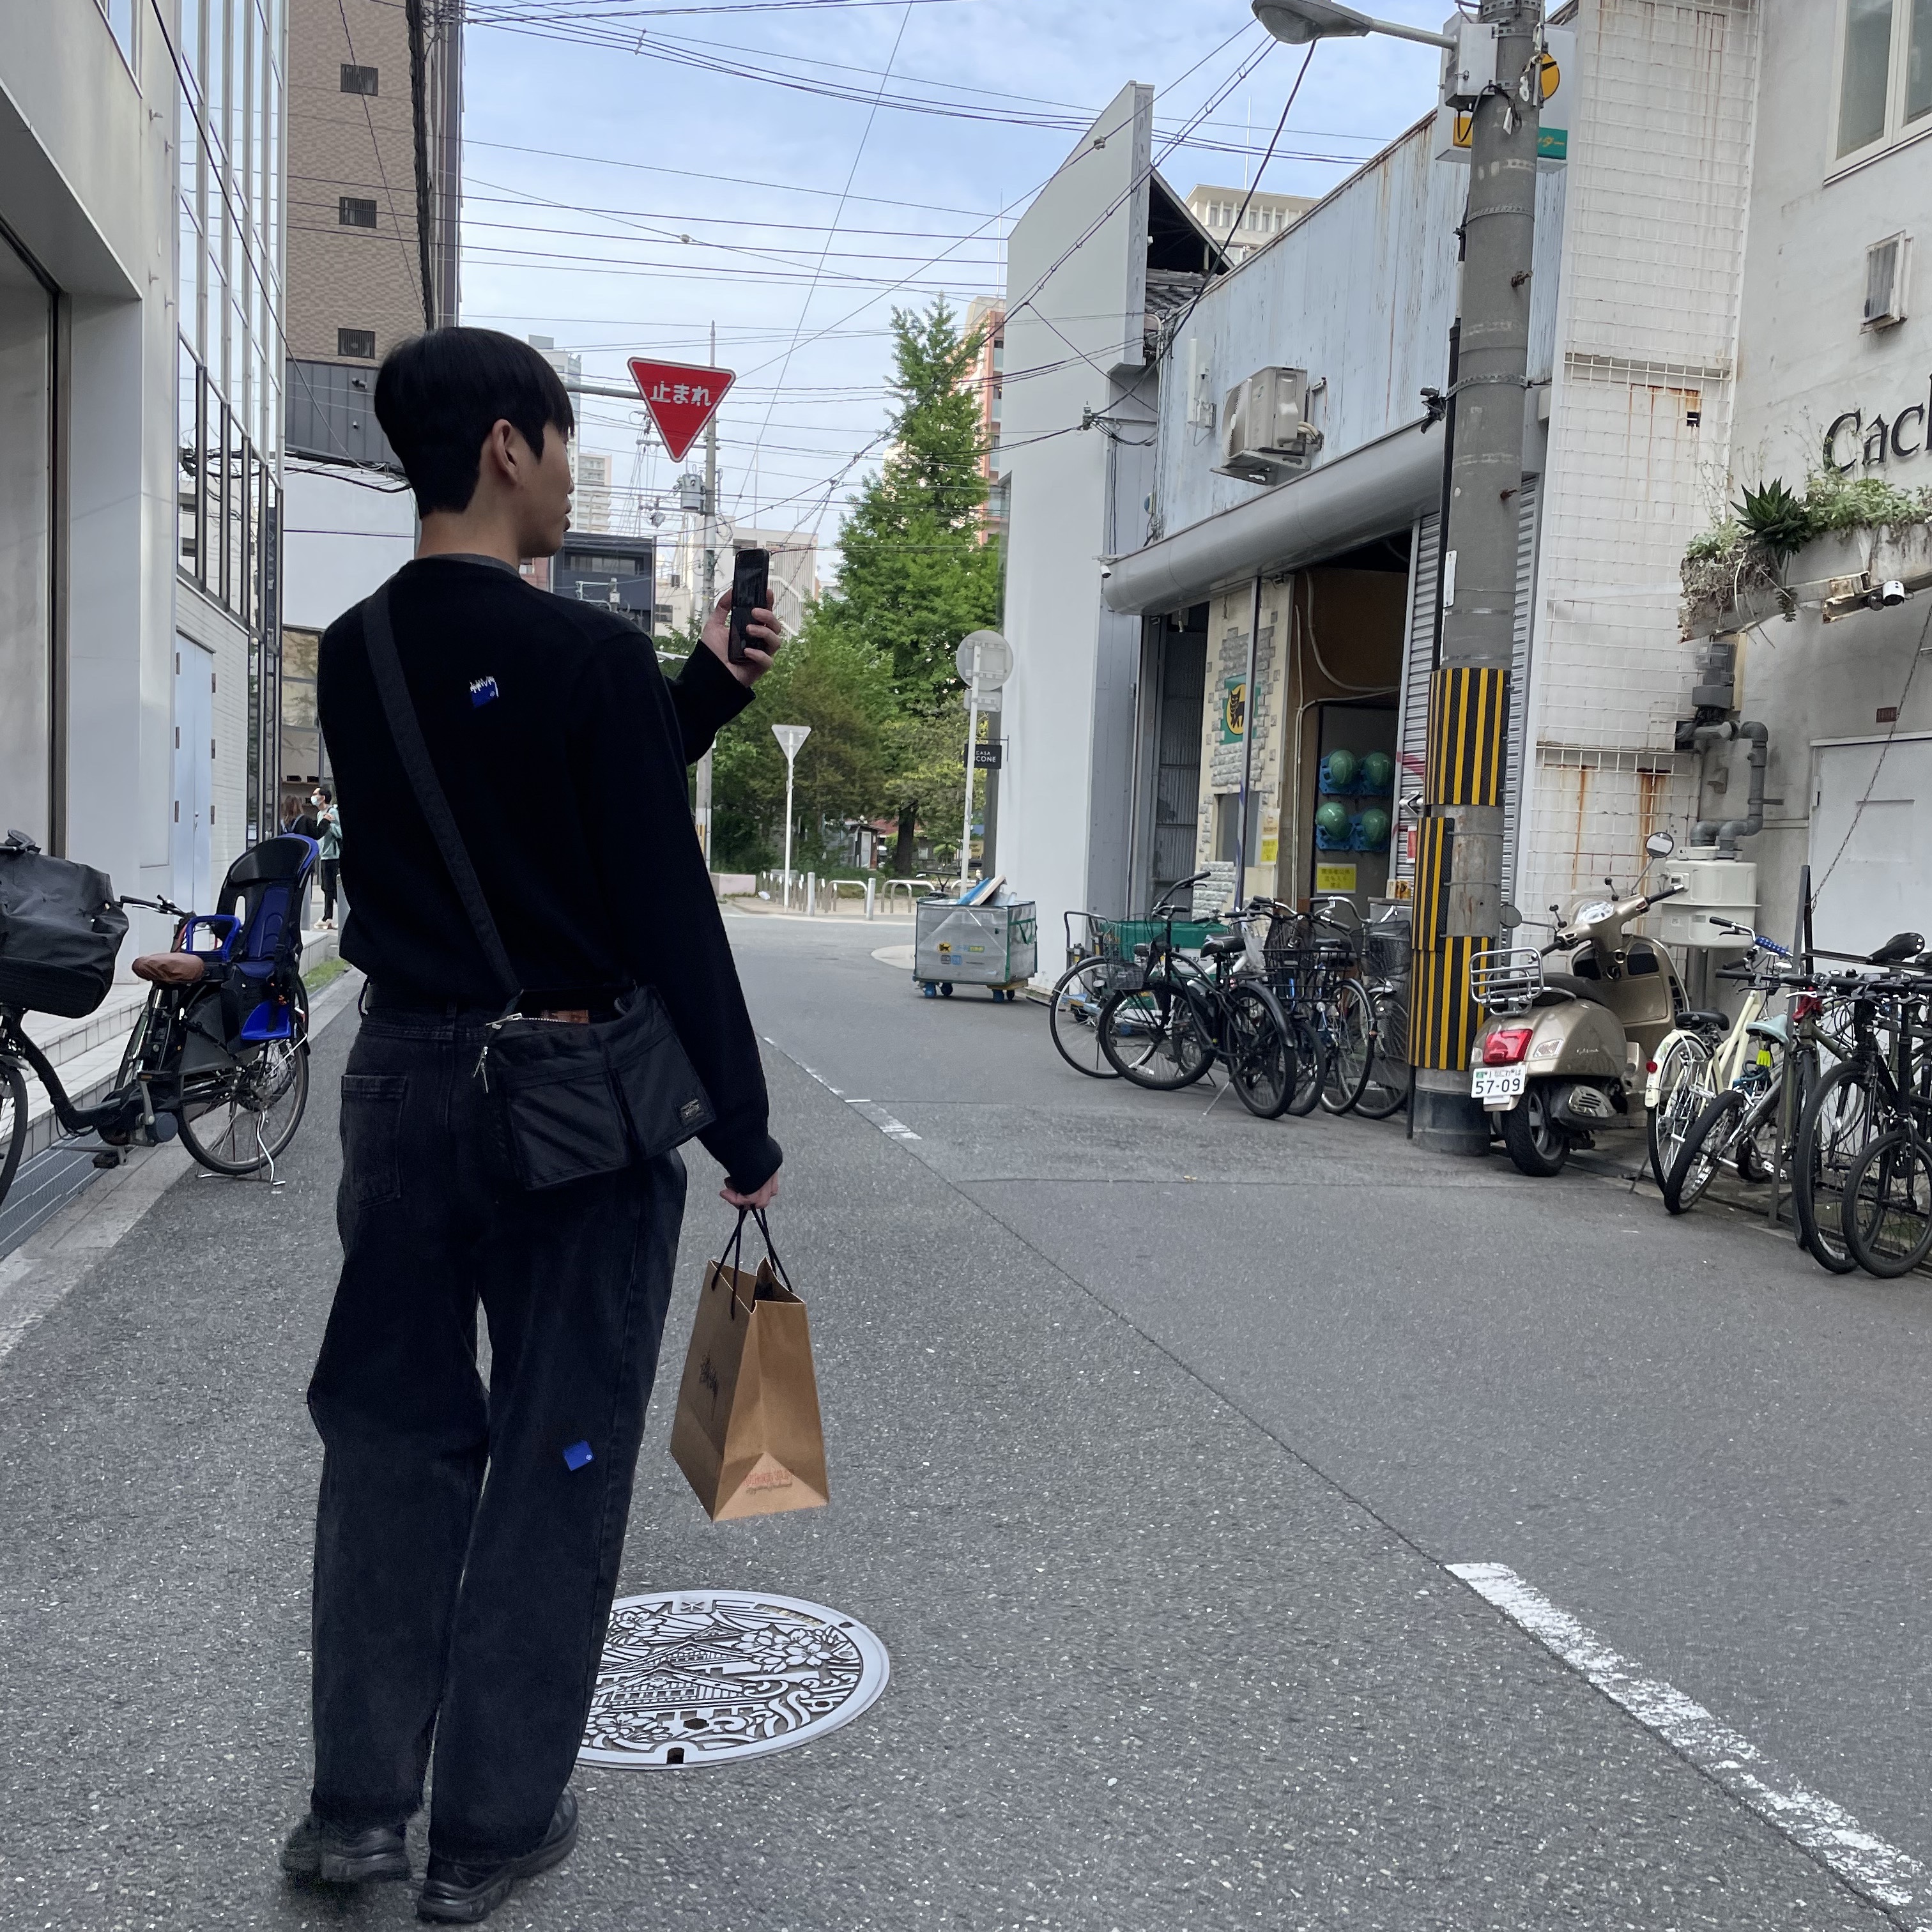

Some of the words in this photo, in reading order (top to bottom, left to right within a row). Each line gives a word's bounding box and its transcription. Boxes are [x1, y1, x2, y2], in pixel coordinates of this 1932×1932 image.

[650, 380, 712, 406] 止まれ
[1823, 372, 1932, 473] Cac
[1475, 1078, 1521, 1094] 57-09
